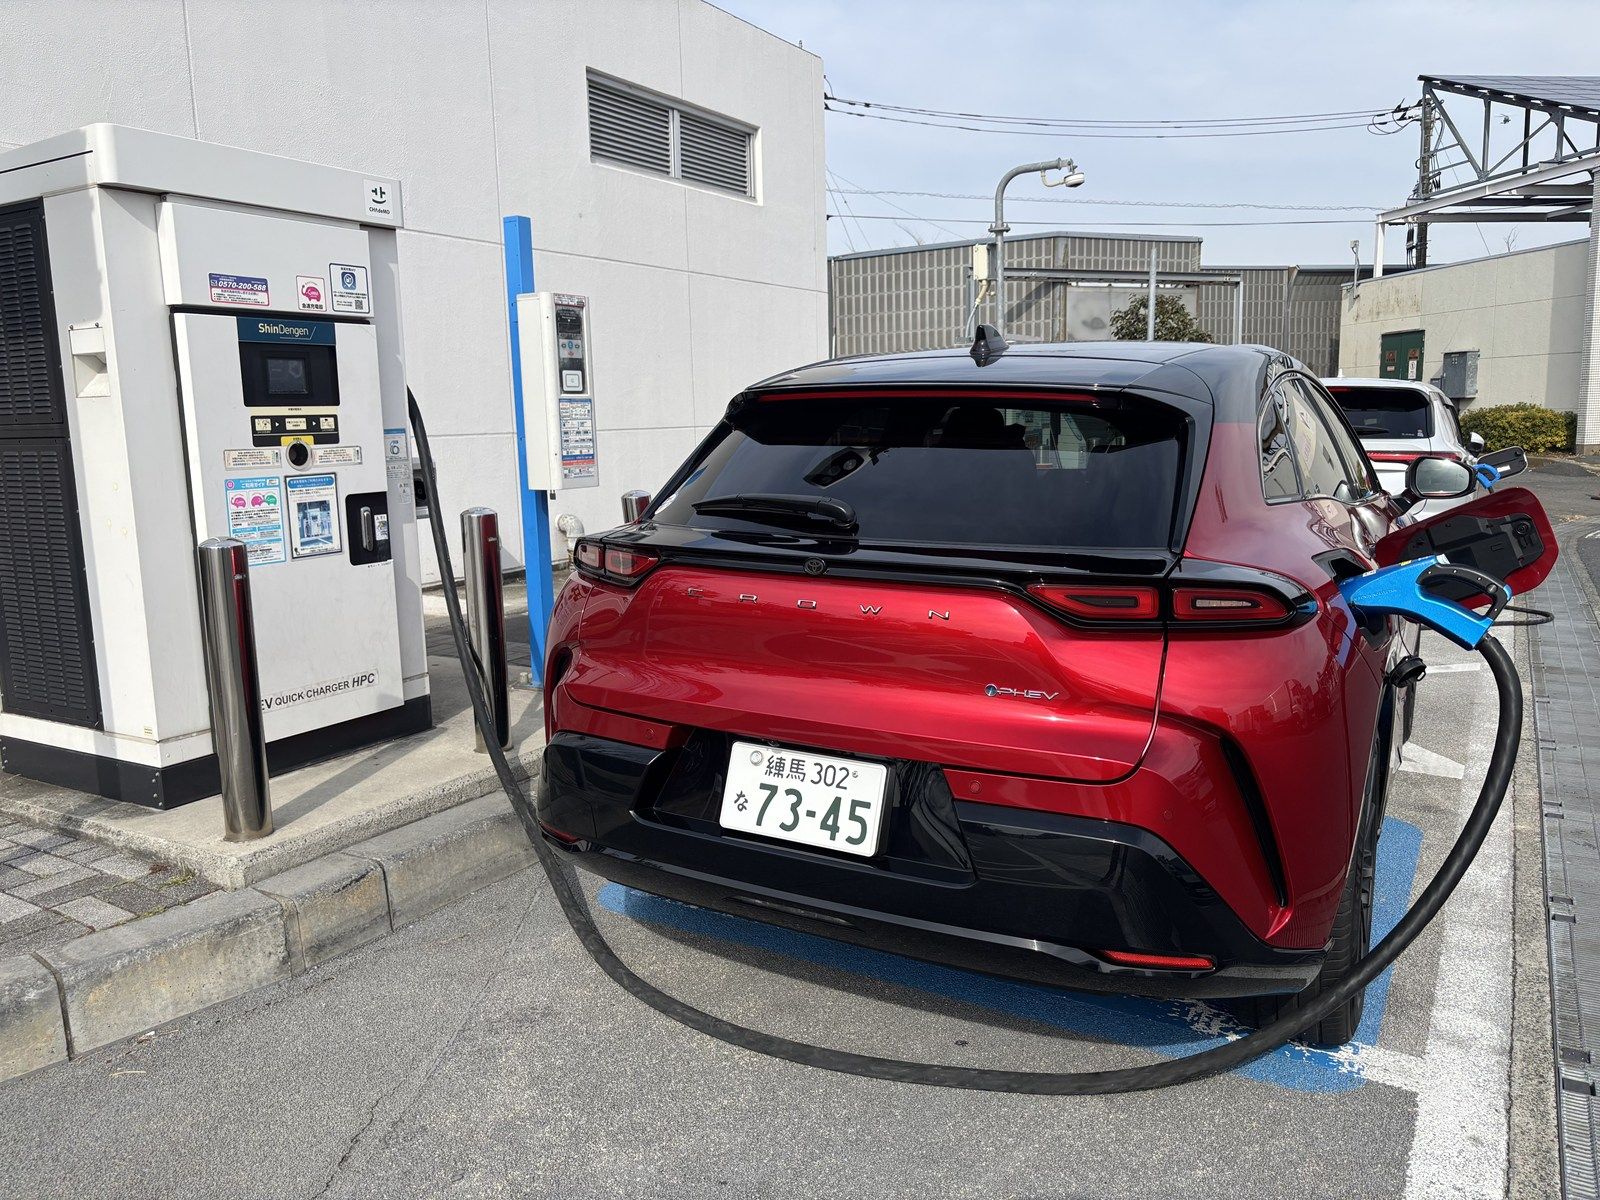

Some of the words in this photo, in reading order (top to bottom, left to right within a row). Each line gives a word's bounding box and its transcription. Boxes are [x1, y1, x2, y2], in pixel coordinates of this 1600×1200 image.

[258, 323, 309, 338] ShinDengen
[688, 588, 950, 620] CROWN
[275, 691, 305, 706] QUICK
[306, 680, 349, 698] CHARGER
[352, 673, 375, 687] HPC
[997, 687, 1059, 700] PHEV
[764, 755, 806, 782] 練馬
[811, 763, 850, 790] 302
[734, 790, 748, 812] な
[756, 783, 872, 846] 73-45
